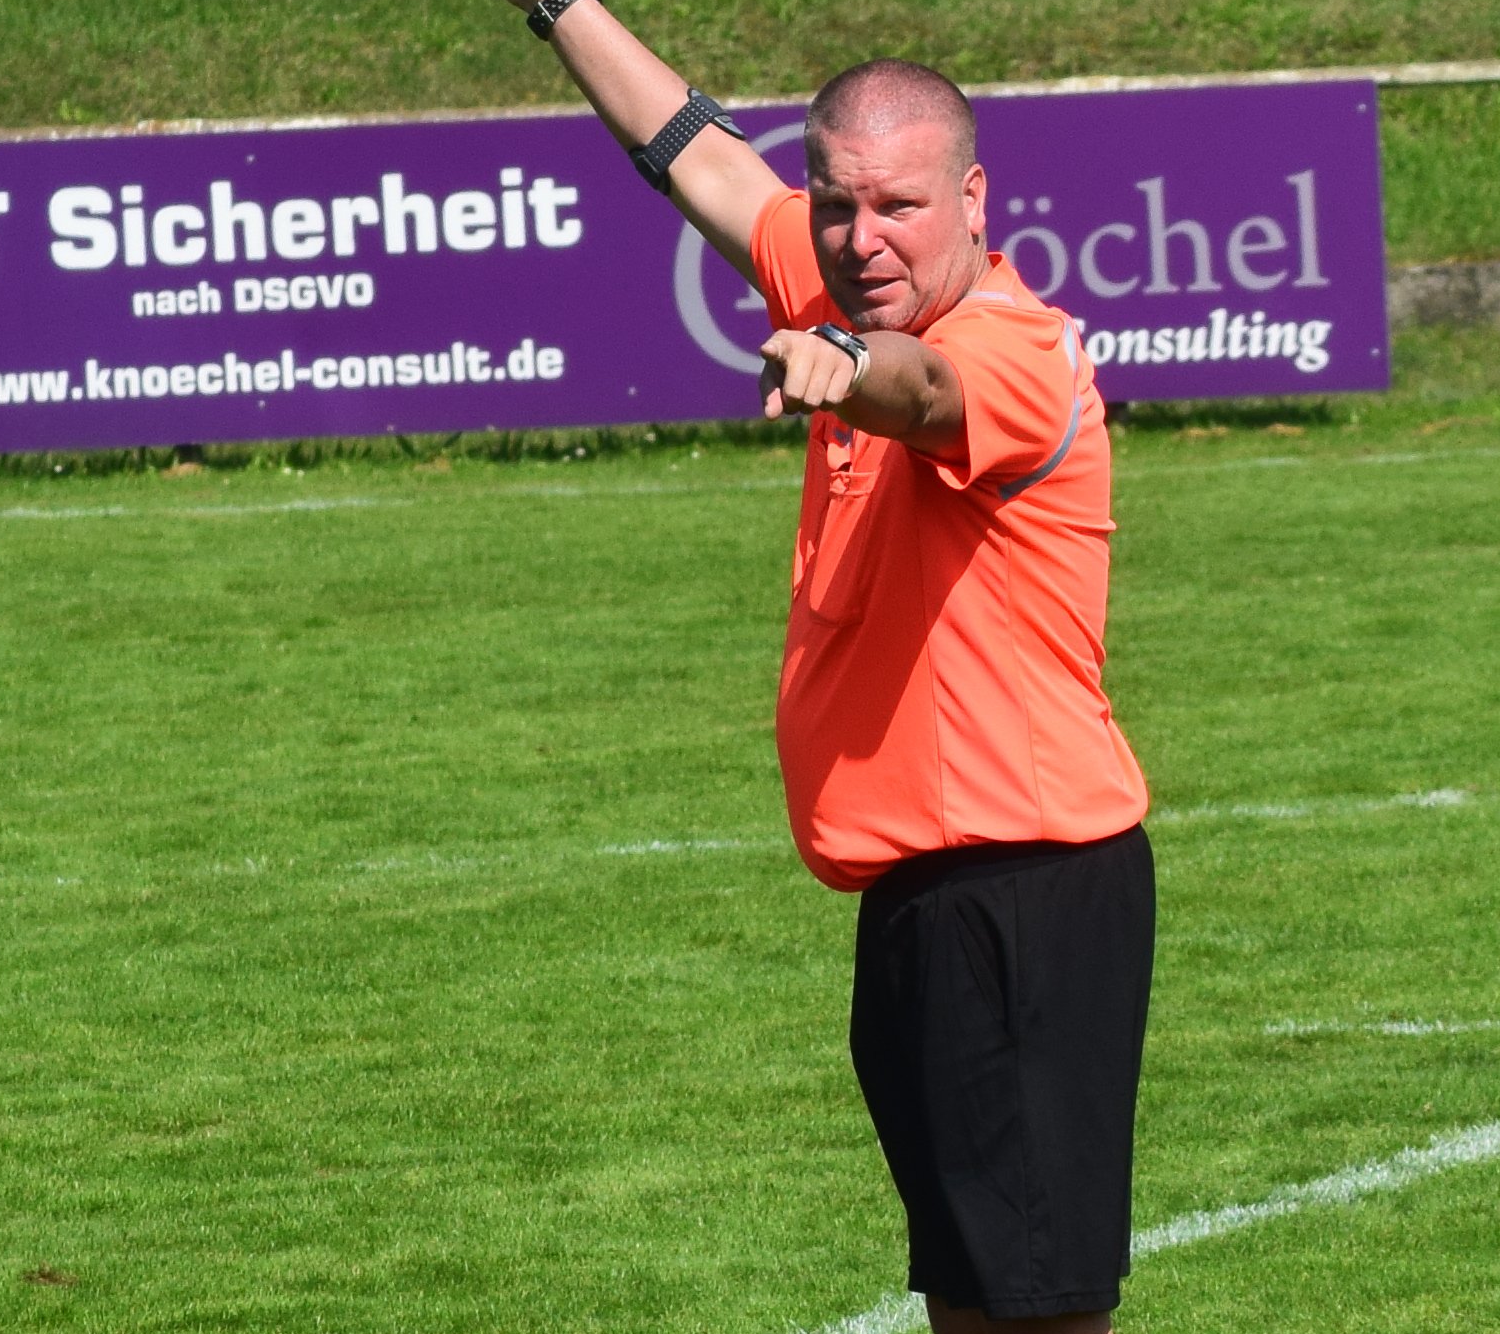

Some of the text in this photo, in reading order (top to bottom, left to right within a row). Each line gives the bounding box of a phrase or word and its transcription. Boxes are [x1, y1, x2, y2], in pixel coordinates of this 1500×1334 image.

[47, 167, 584, 271] Sicherheit
[1001, 169, 1331, 300] öchel
[132, 271, 375, 318] nach DSGVO
